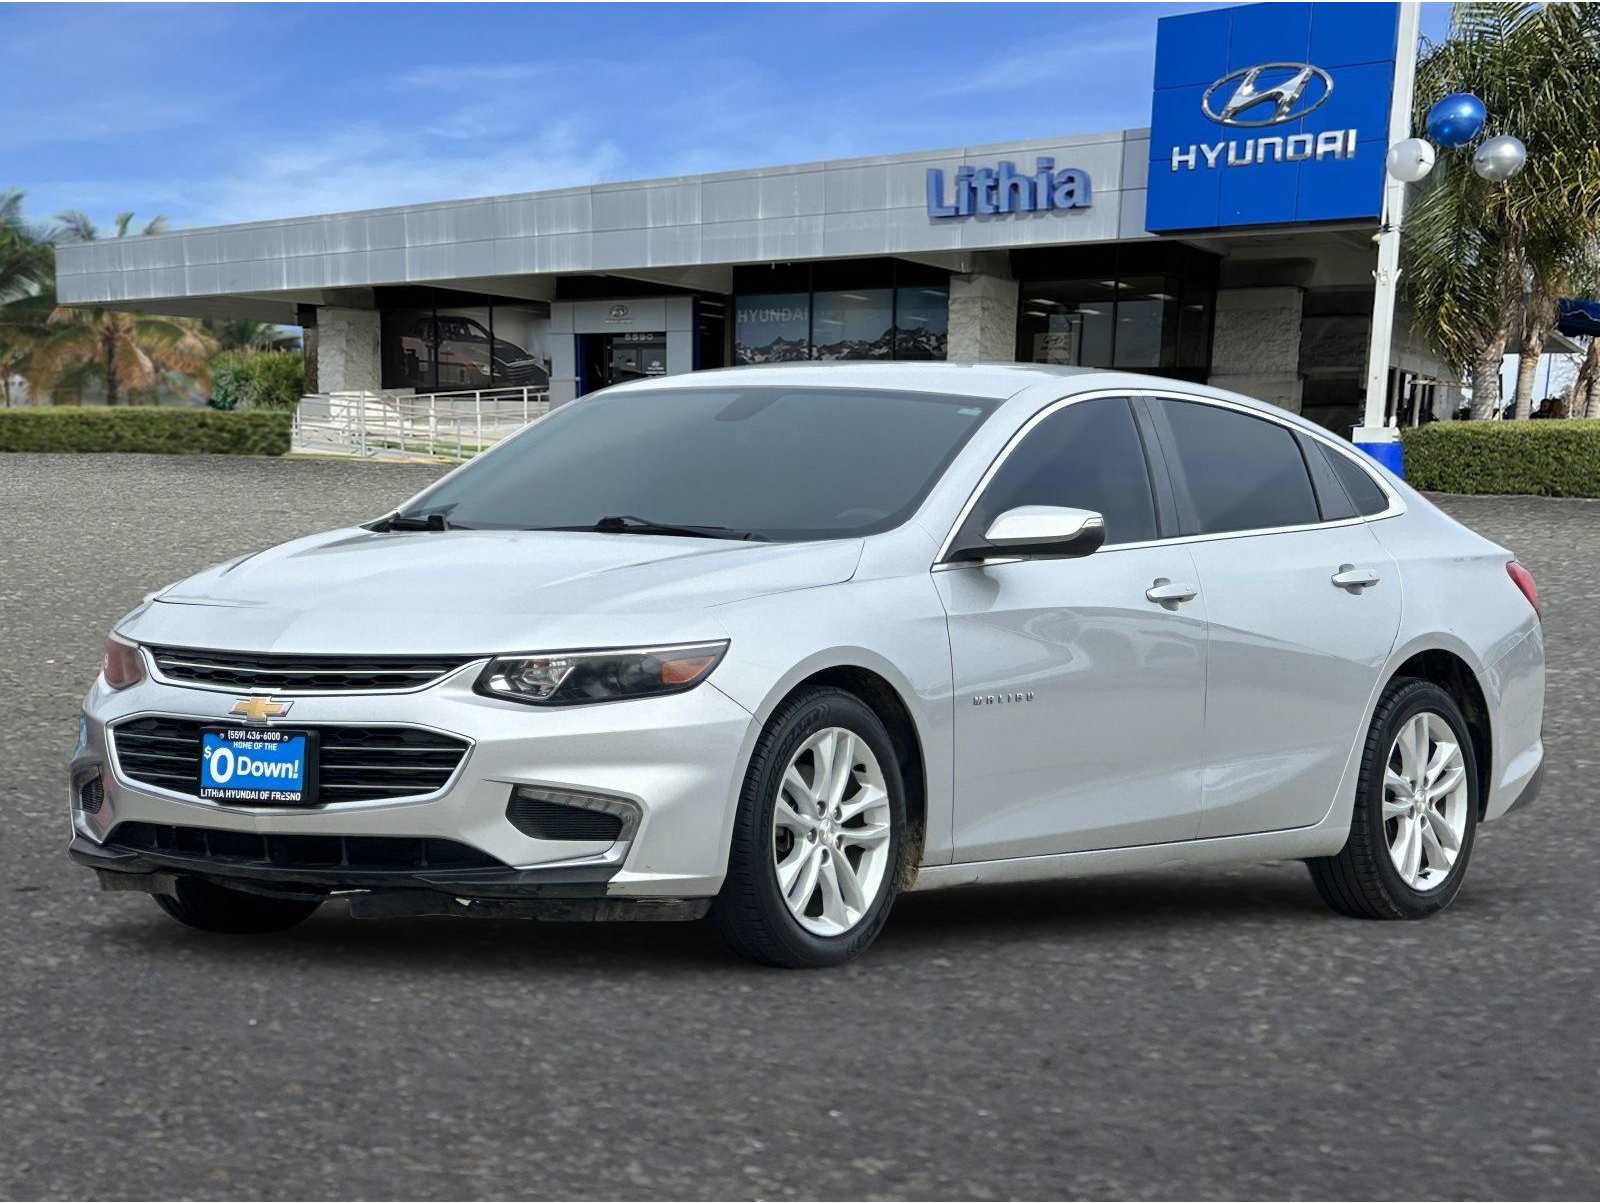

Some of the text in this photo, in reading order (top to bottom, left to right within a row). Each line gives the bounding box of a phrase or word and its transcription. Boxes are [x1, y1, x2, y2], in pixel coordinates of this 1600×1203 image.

[1171, 129, 1357, 171] HYUNDAI
[927, 157, 1092, 217] Lithia
[737, 307, 808, 322] HYUNDAI
[227, 730, 281, 741] (559) 436-6000
[233, 741, 278, 751] HOME OF THE
[237, 756, 299, 779] Down!
[200, 788, 301, 801] LITHIA HYUNDAI OF FRESNO
